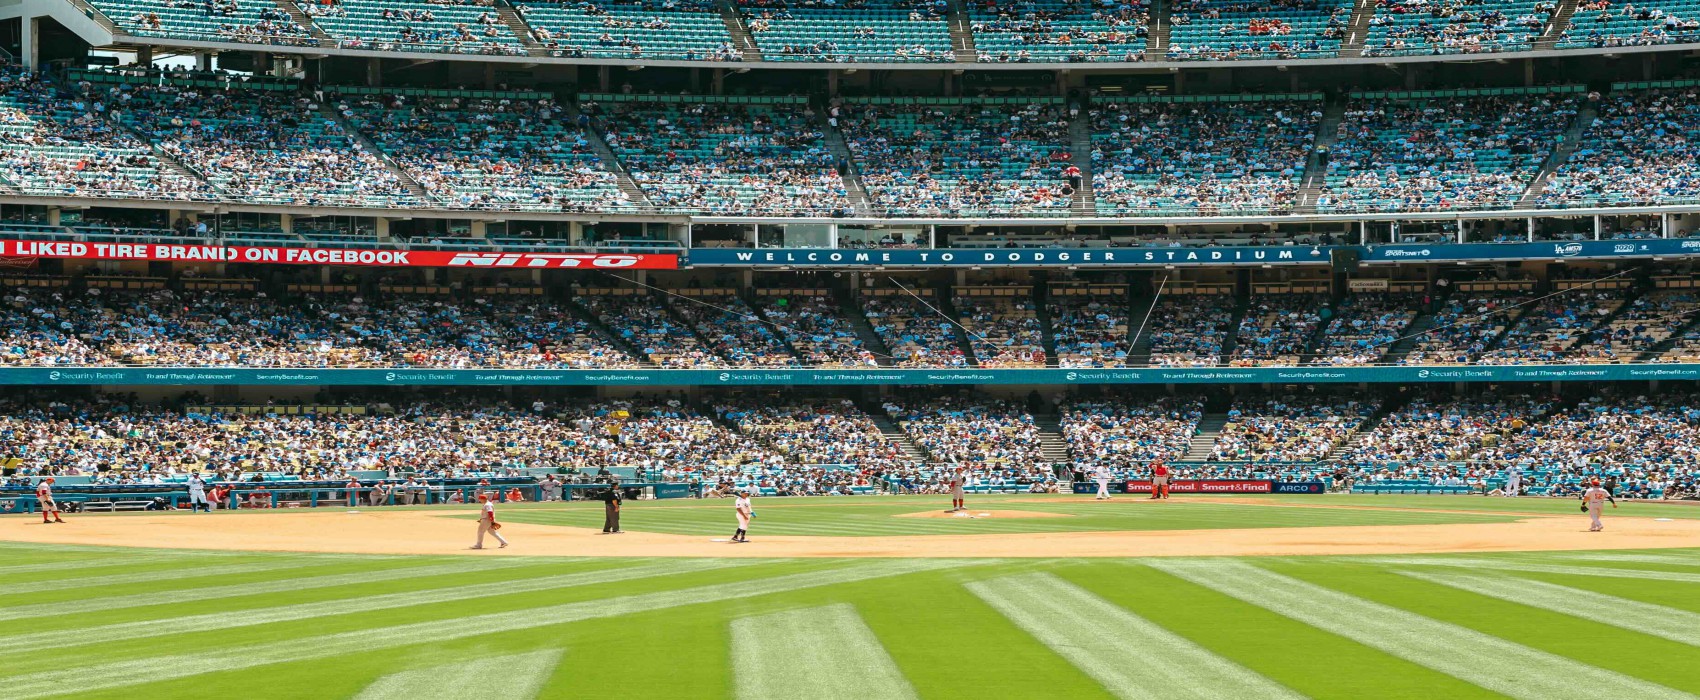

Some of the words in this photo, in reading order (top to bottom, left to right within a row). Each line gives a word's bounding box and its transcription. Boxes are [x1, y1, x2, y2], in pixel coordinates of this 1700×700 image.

[1614, 243, 1634, 251] 1020
[17, 242, 87, 256] LIKED
[94, 244, 147, 257] TIRE
[156, 244, 237, 259] BRAND
[245, 248, 278, 261] ON
[287, 248, 409, 264] FACEBOOK
[737, 253, 889, 261] WELCOME
[921, 253, 953, 261] TO
[985, 253, 1114, 261] DODGER
[1146, 251, 1293, 260] STADIUM
[1128, 483, 1196, 491] SmaFinal.
[1202, 483, 1270, 491] Smart&Final.
